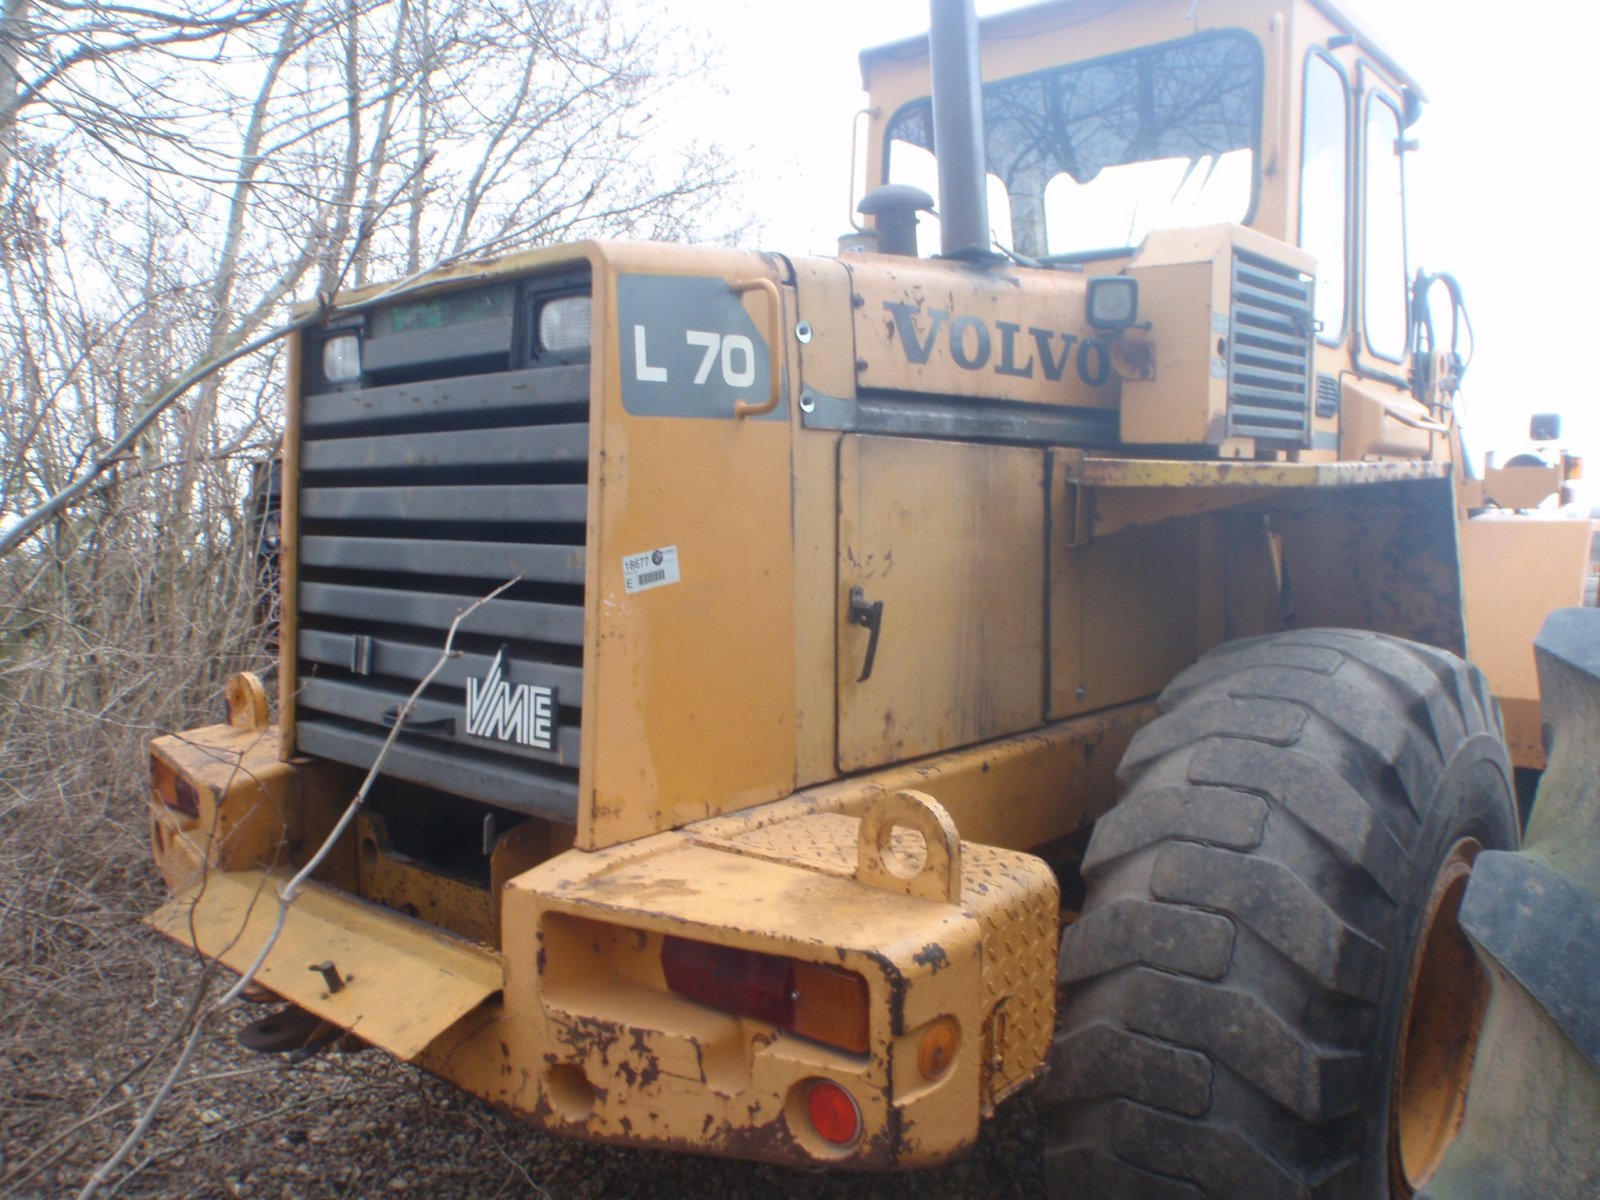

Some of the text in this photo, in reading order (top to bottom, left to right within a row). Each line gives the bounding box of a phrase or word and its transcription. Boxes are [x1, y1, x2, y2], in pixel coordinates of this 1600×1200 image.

[634, 324, 755, 387] L 70
[883, 301, 1111, 387] VOLVO
[466, 649, 552, 750] VME
